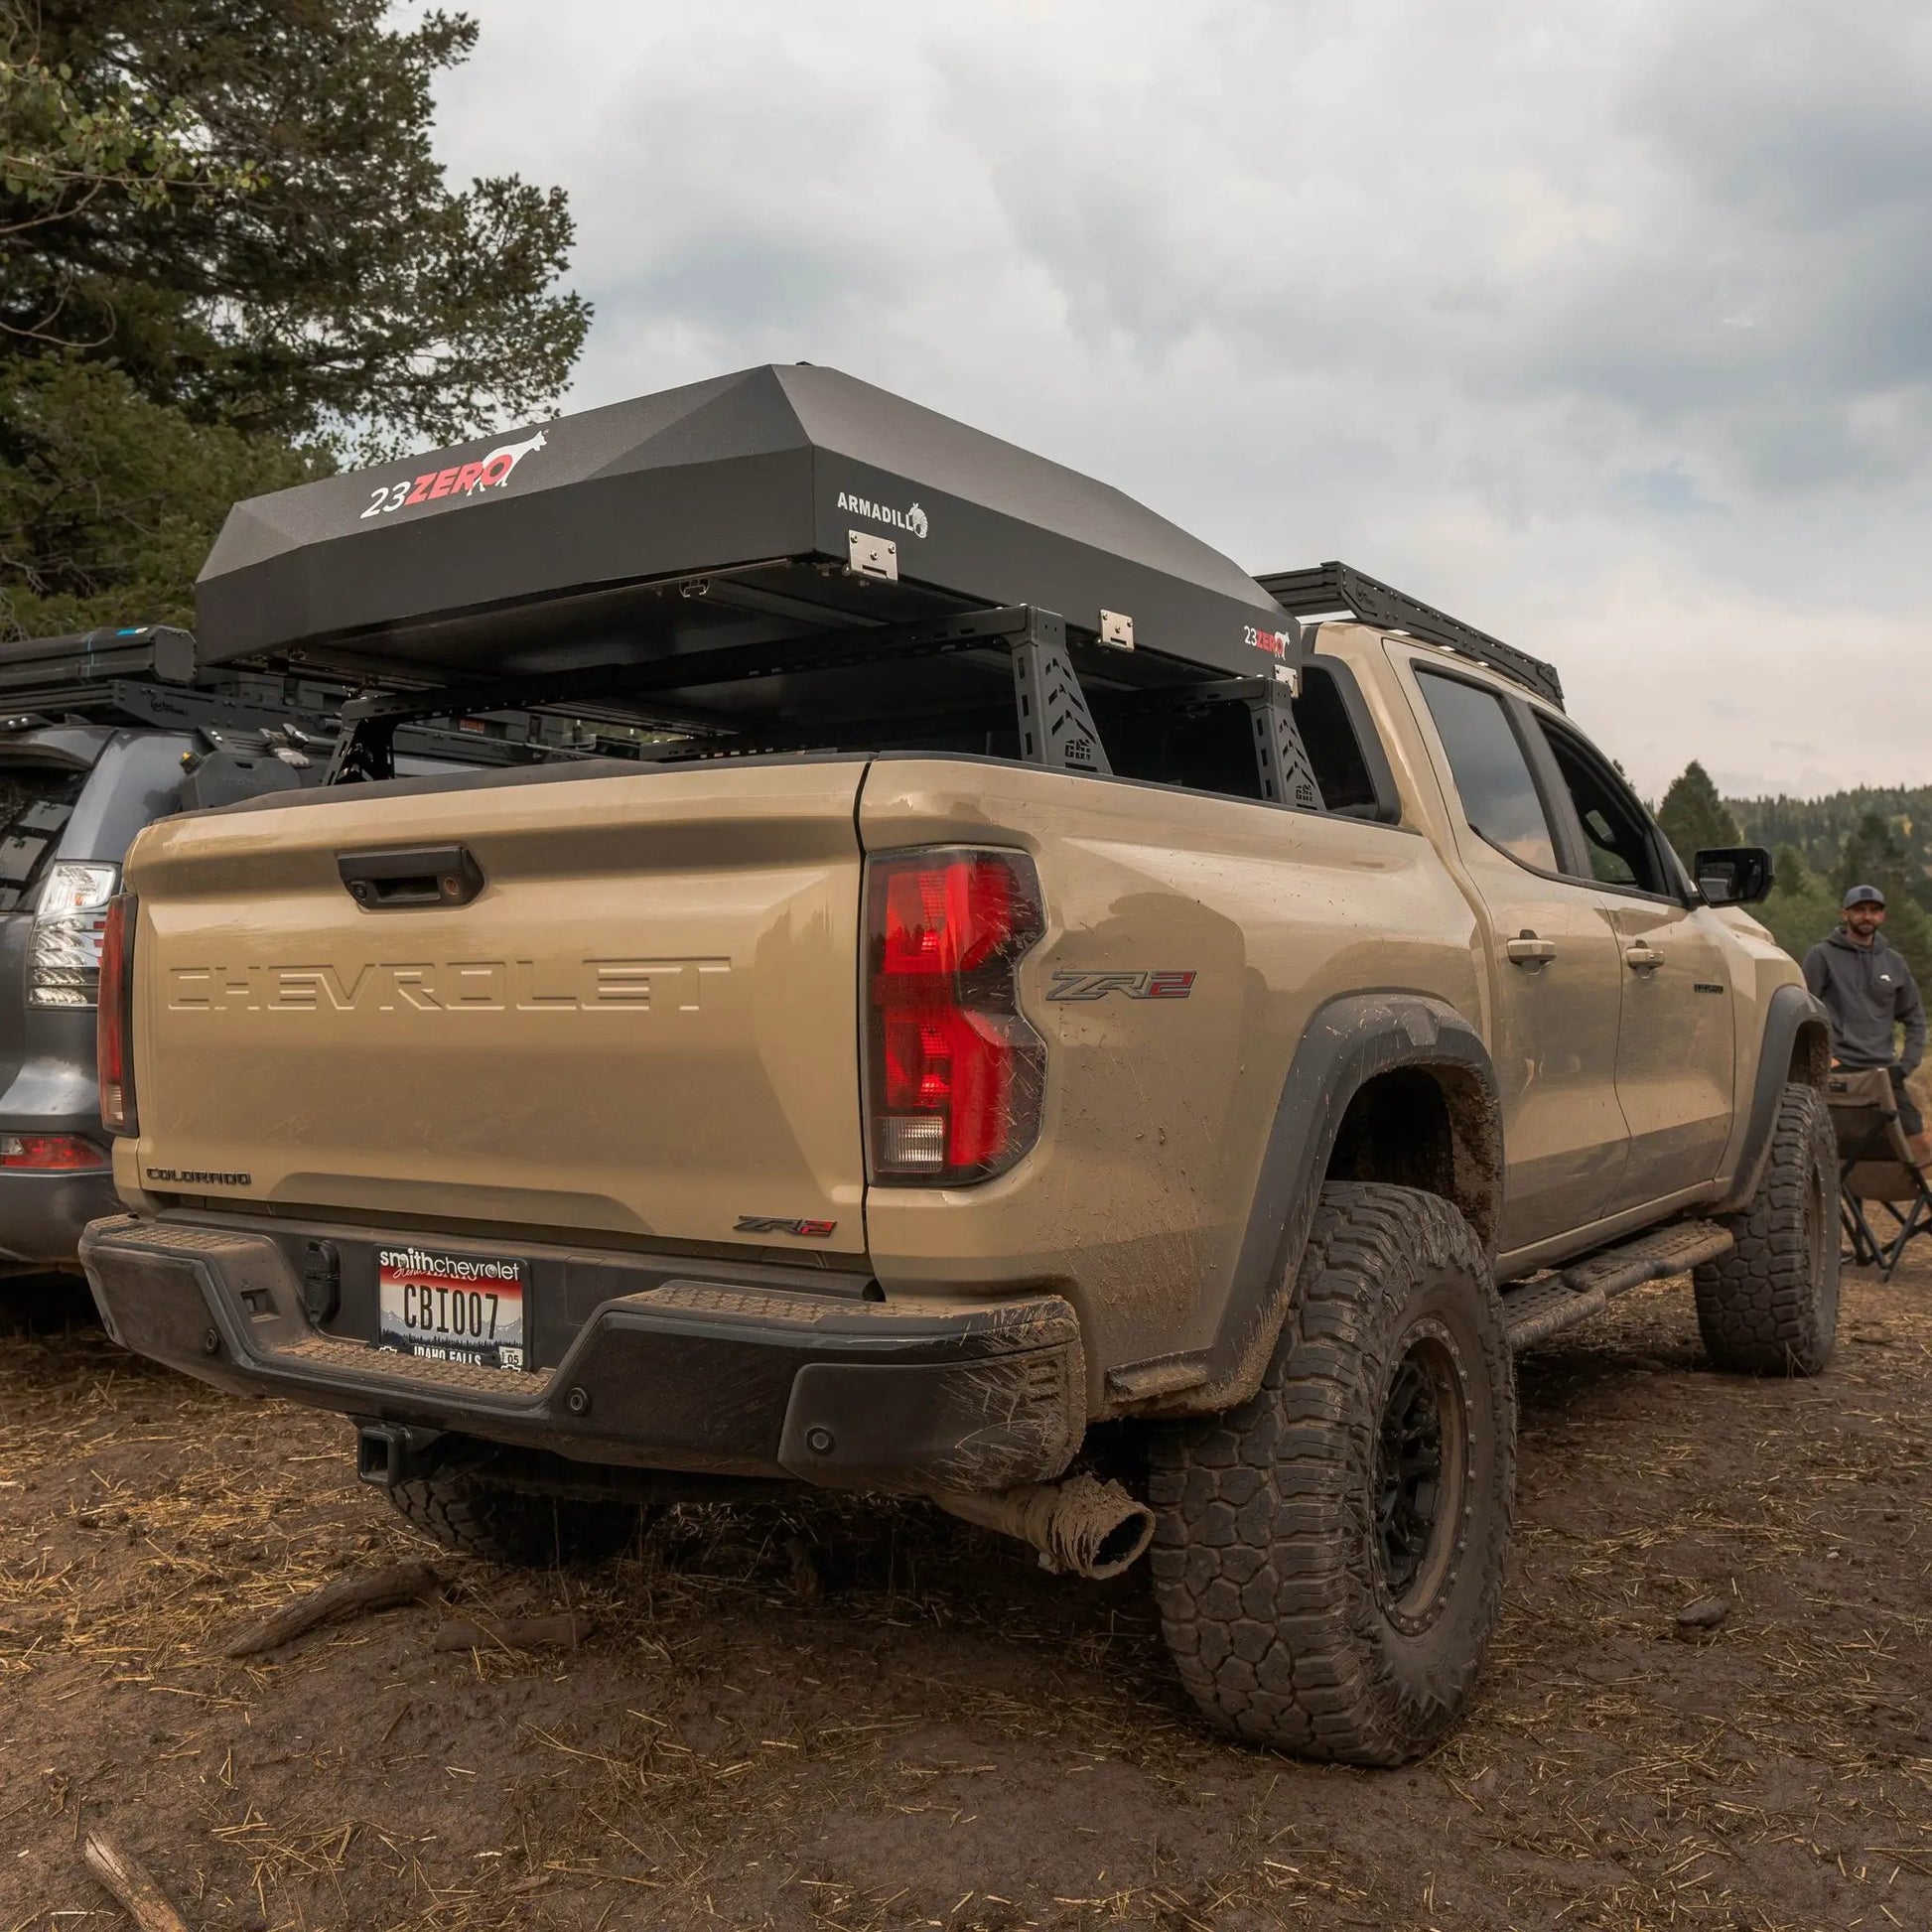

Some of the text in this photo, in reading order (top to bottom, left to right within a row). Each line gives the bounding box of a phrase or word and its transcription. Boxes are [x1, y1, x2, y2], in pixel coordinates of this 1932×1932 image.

[360, 454, 513, 518] 23ZERO
[1244, 625, 1284, 655] 23ZERO
[169, 956, 731, 1011] CHEVROLET
[1045, 969, 1197, 1001] ZR2
[146, 1168, 252, 1185] COLORADO
[733, 1215, 837, 1237] ZR2
